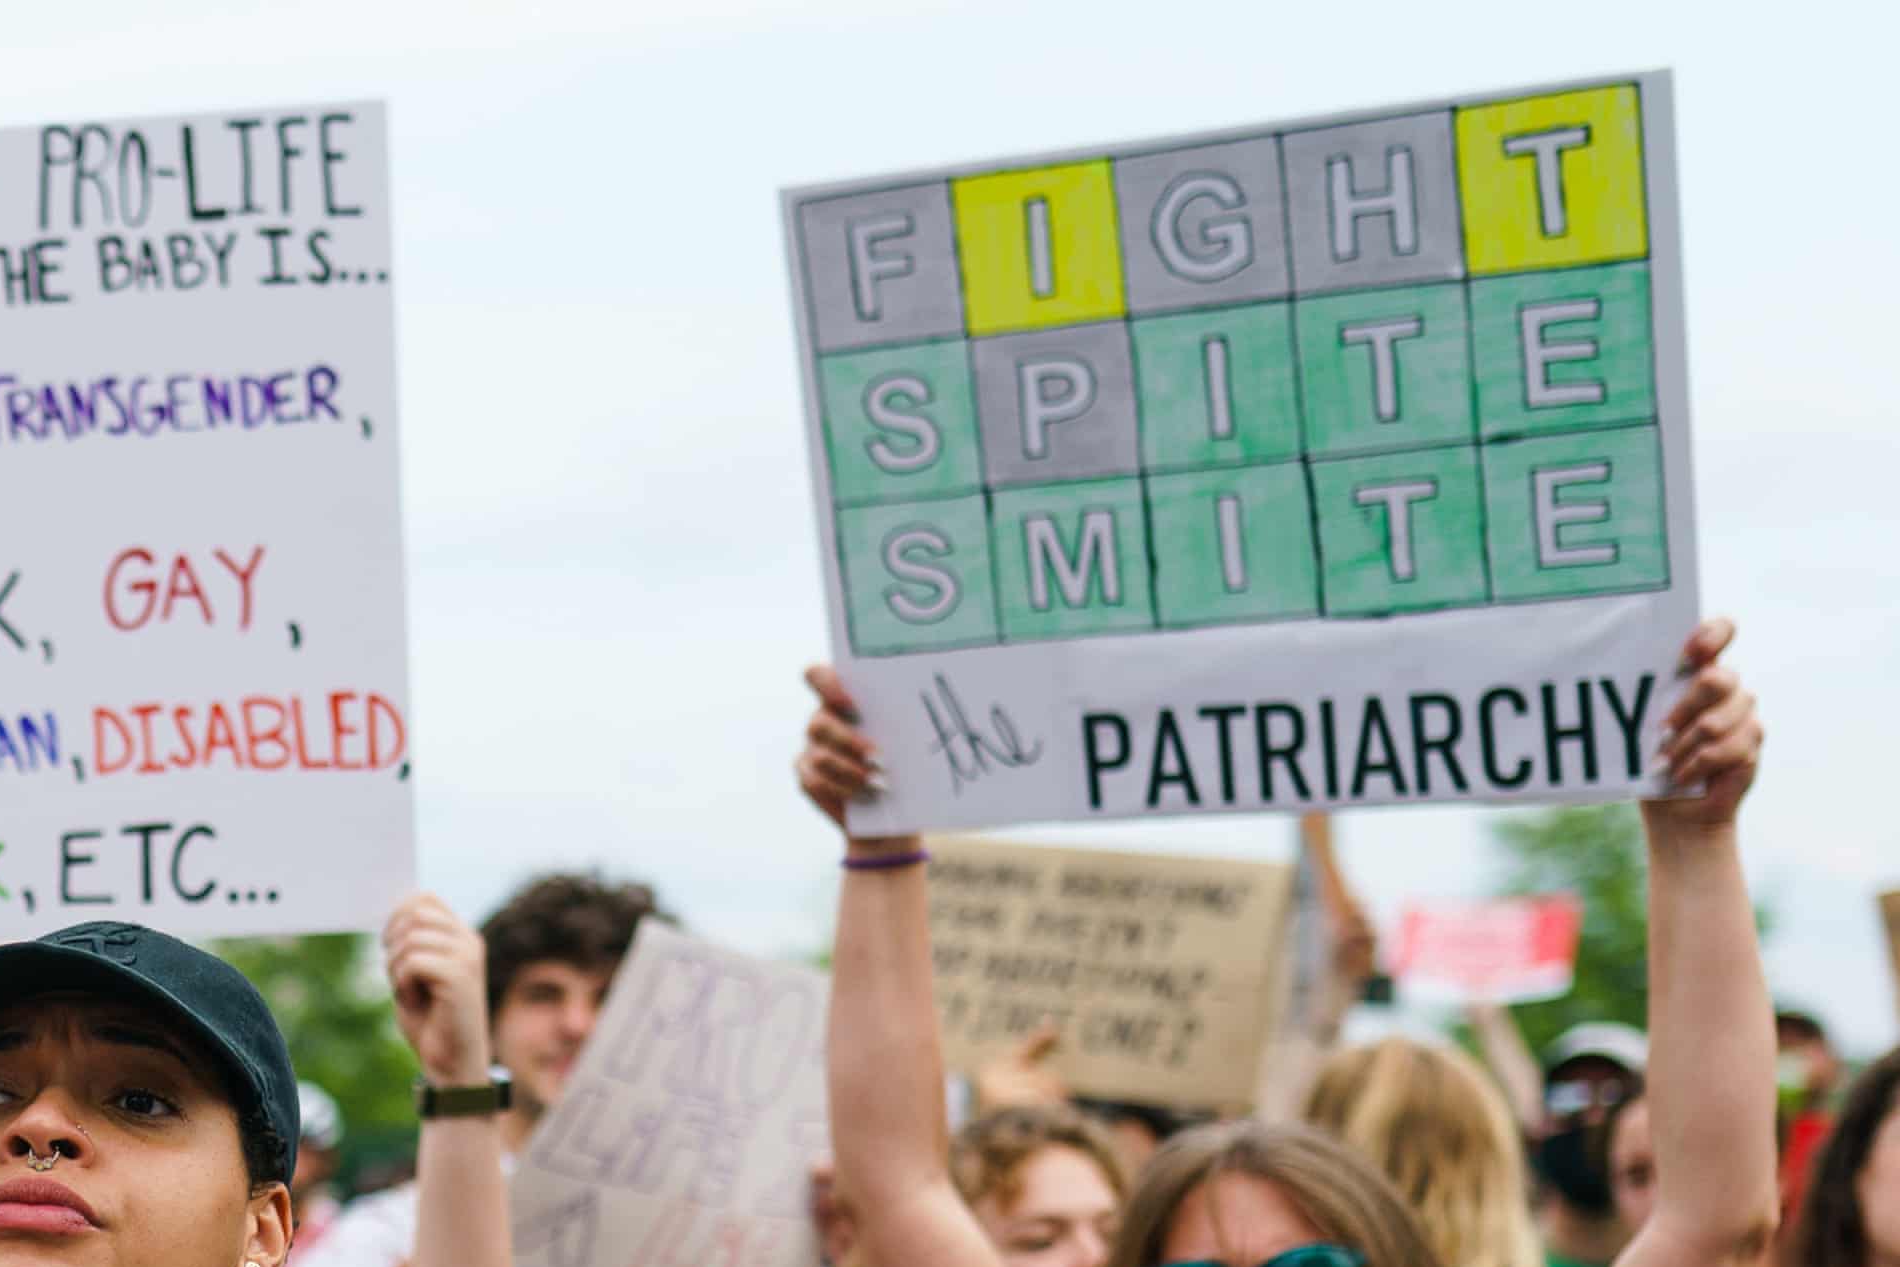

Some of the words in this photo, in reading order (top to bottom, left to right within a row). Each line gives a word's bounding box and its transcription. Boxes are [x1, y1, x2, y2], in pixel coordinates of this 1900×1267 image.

[38, 112, 363, 229] PRO-LIFE
[846, 125, 1592, 323] FIGHT
[98, 232, 237, 293] BABY
[257, 227, 389, 286] IS...
[864, 297, 1606, 474] SPITE
[882, 461, 1620, 624] SMITE
[92, 691, 411, 782] DISABLED,
[919, 671, 1043, 796] the
[1081, 673, 1656, 809] PATRIARCHY
[59, 822, 280, 904] ETC...
